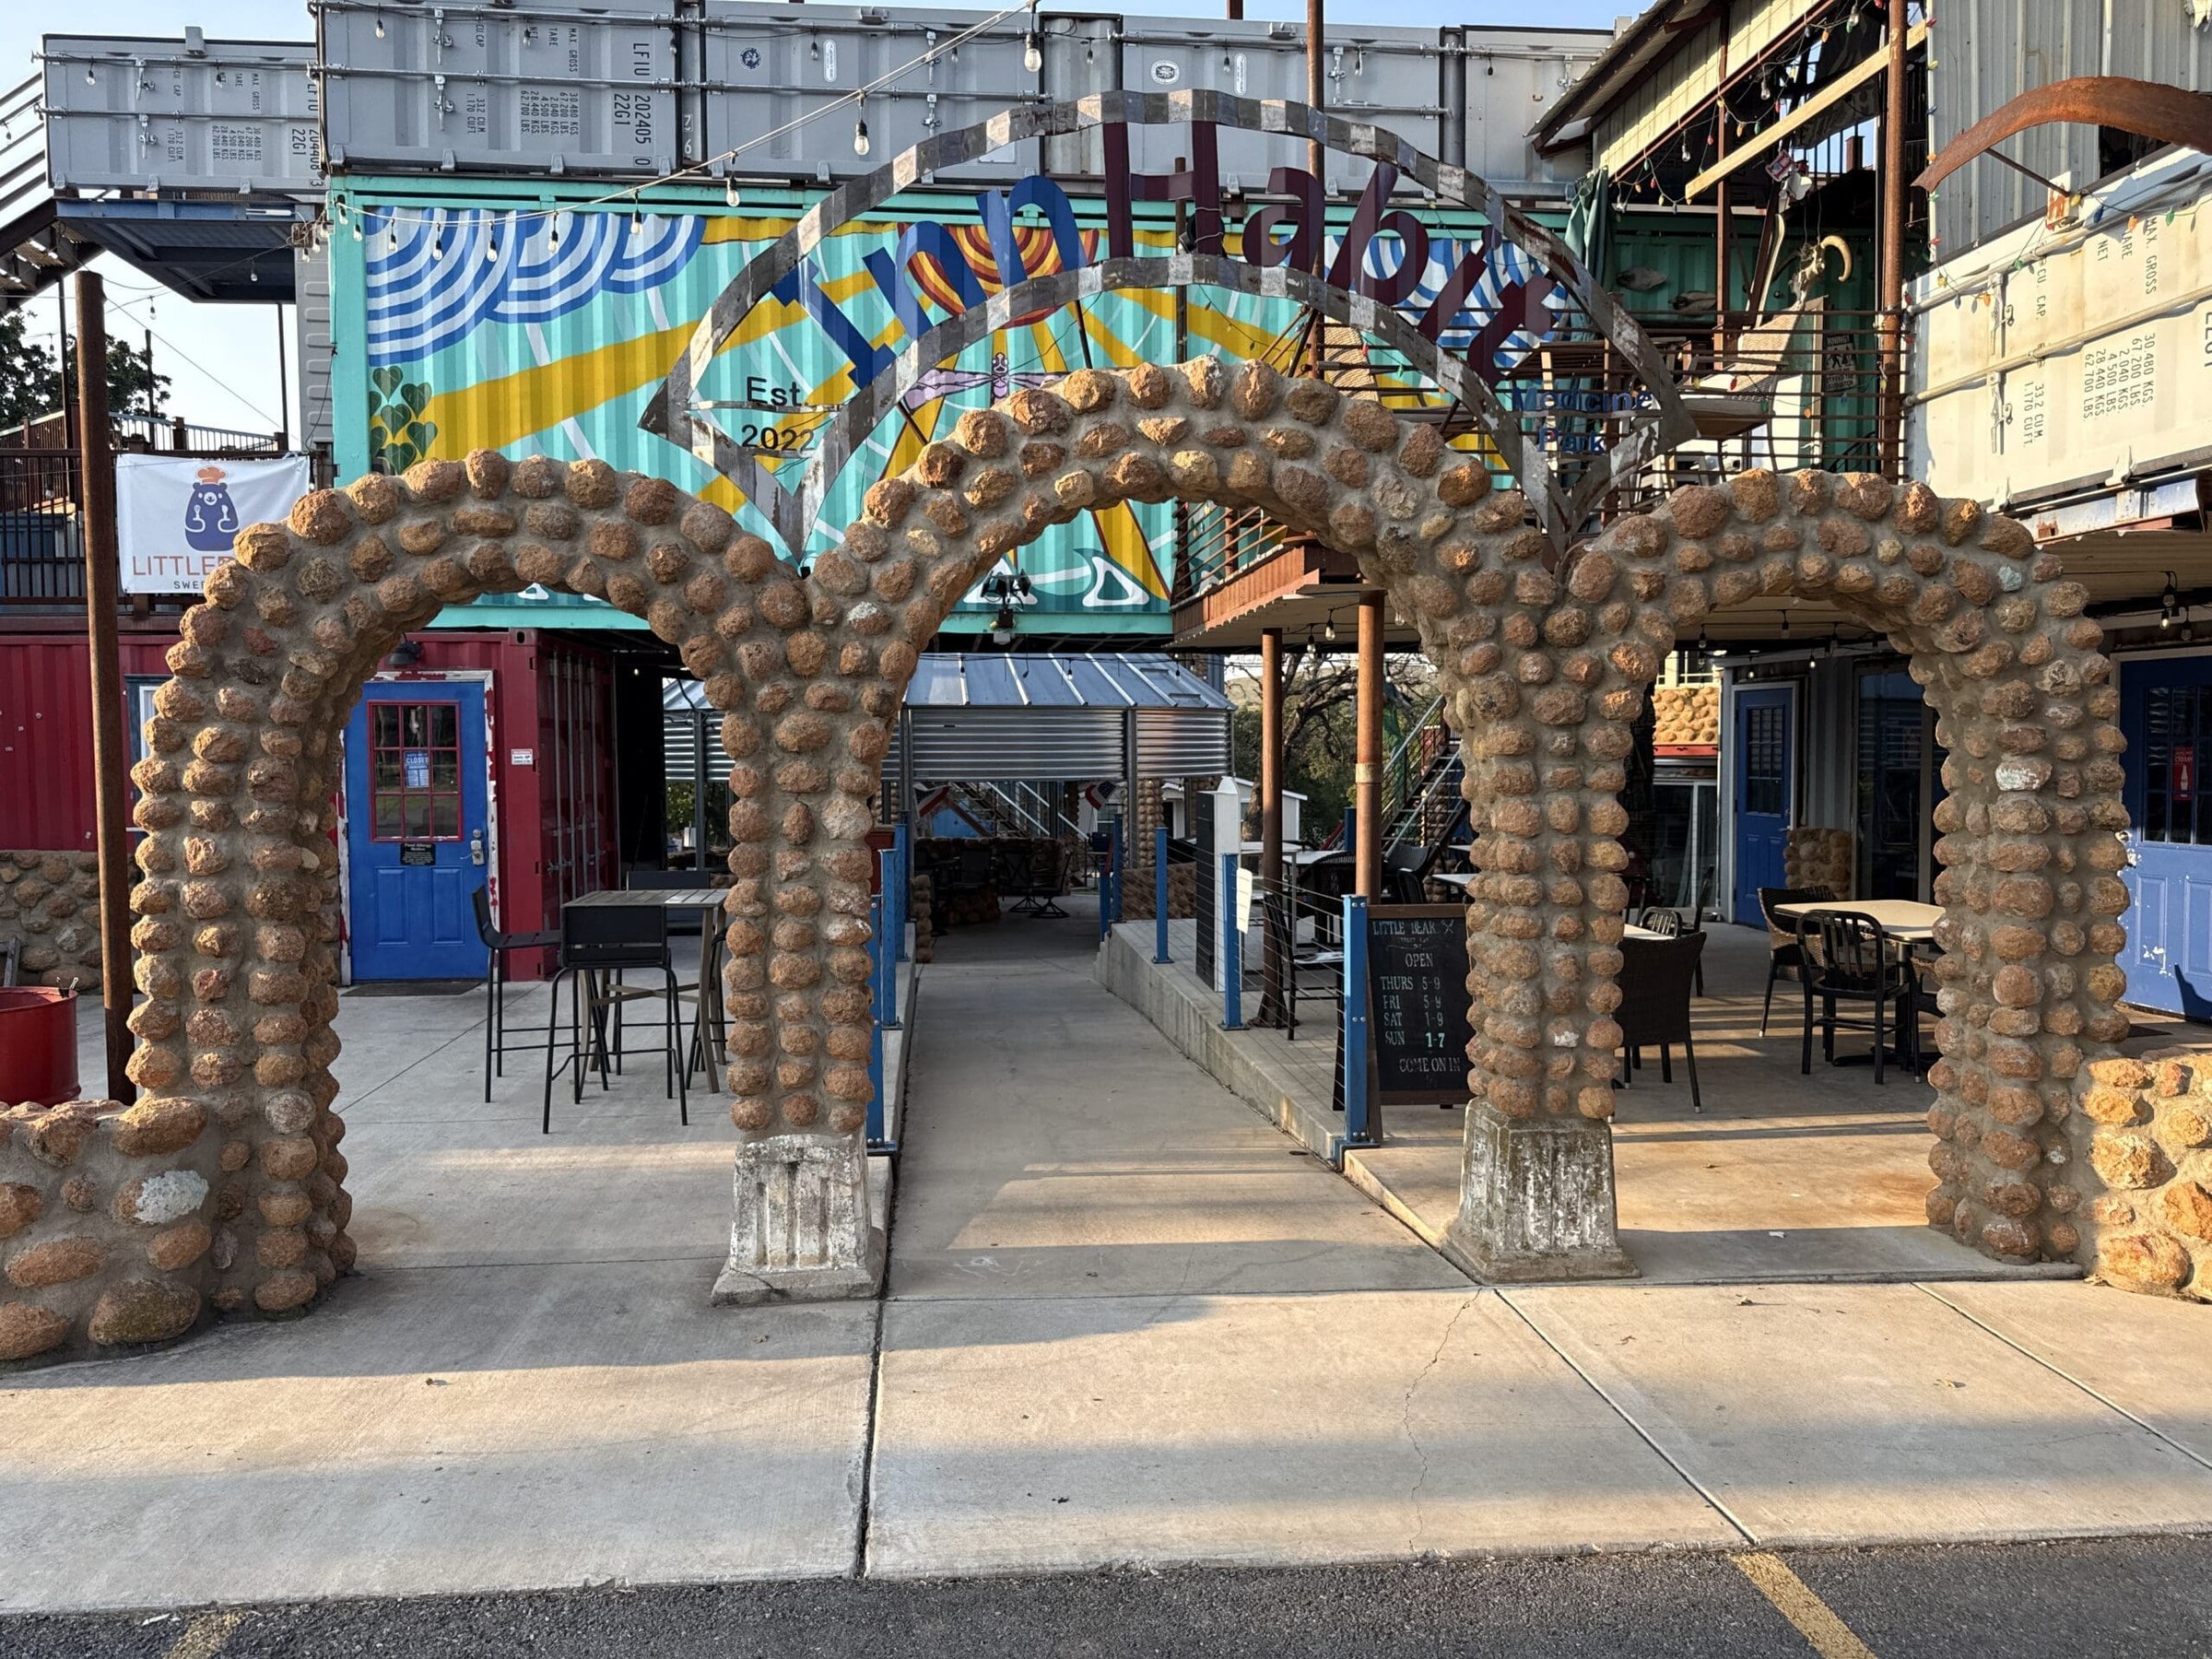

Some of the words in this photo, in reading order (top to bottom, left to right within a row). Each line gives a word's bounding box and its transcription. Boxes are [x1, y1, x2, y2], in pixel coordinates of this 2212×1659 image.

[528, 26, 538, 40] NET
[548, 28, 559, 47] TARE
[569, 50, 578, 72] GROSS
[633, 42, 650, 76] LFIU
[235, 73, 243, 88] TARE
[252, 91, 260, 111] GROSS
[614, 94, 630, 125] 22G1
[634, 96, 651, 144] 202405
[291, 129, 306, 156] 22G1
[2098, 240, 2109, 262] NET
[2146, 255, 2157, 295] GROSS
[747, 376, 808, 406] Est.
[1512, 387, 1653, 412] Medicine
[741, 424, 815, 453] 2022
[1538, 427, 1606, 455] Park
[173, 581, 205, 590] SWE
[1372, 921, 1405, 935] LITTLE
[1405, 953, 1433, 968] OPEN
[1380, 975, 1414, 991] THURS
[1422, 976, 1441, 991] 5-9
[1383, 994, 1401, 1009] FRI
[1383, 1012, 1402, 1027] SAT
[1425, 1012, 1443, 1027] 1-9
[1384, 1030, 1405, 1045] SUN
[1425, 1031, 1445, 1048] 1-7
[1399, 1057, 1430, 1073] COME
[1430, 1057, 1446, 1072] ON
[1449, 1057, 1461, 1072] IN
